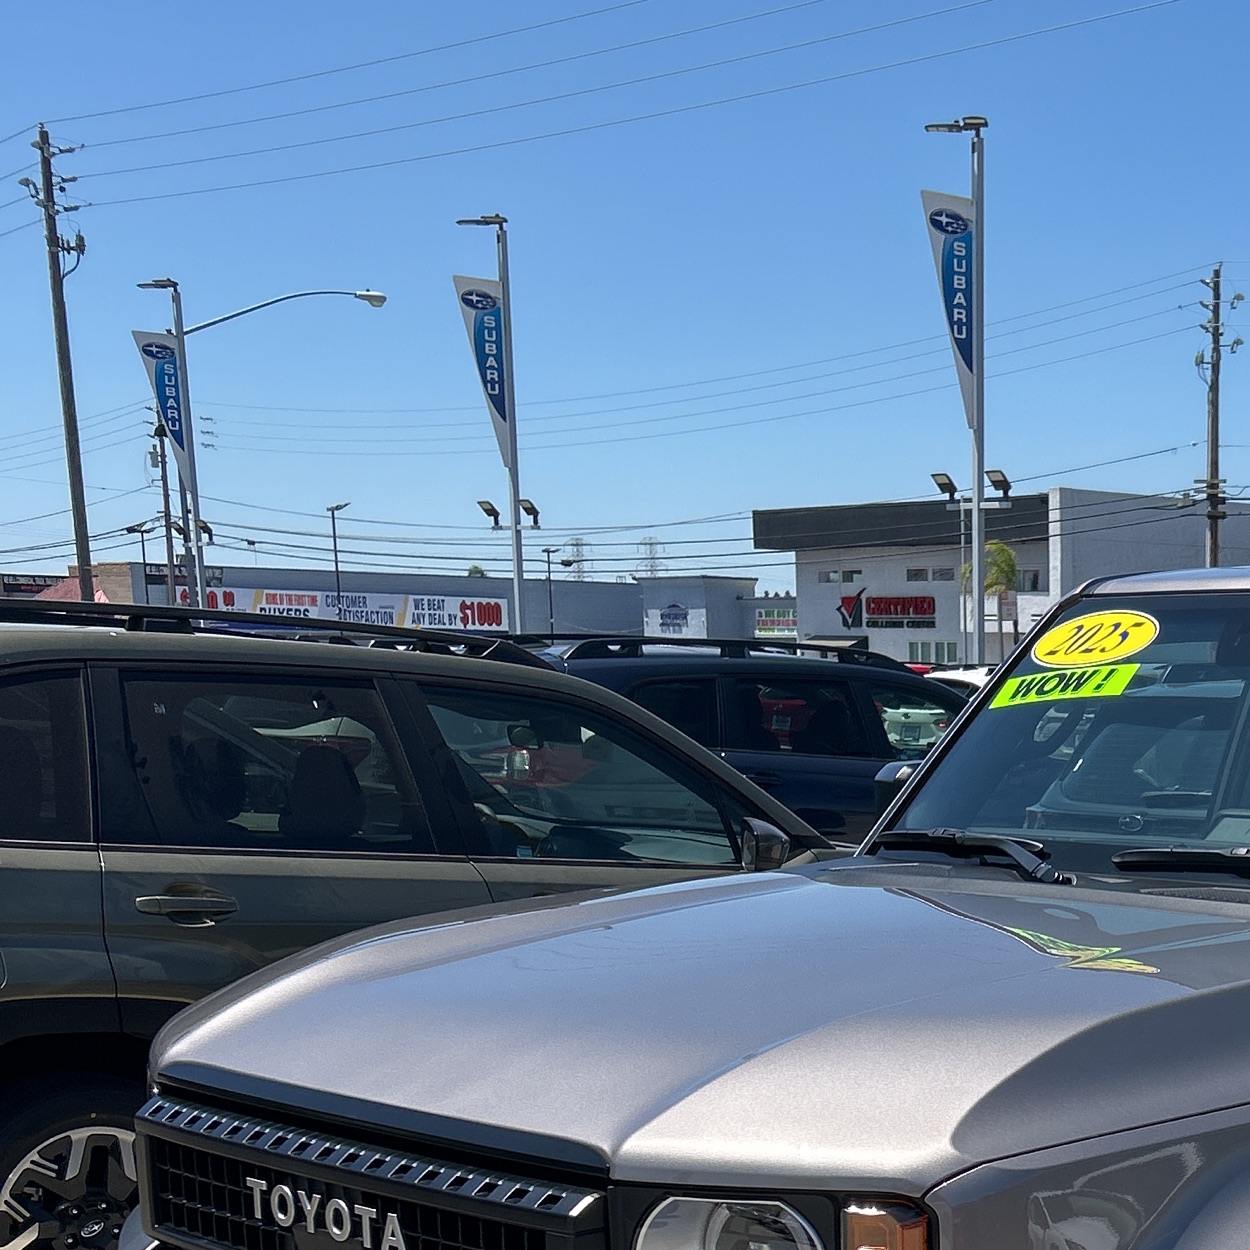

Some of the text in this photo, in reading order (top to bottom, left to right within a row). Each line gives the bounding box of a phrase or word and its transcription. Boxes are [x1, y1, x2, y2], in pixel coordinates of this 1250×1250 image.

[953, 241, 968, 339] SUBARU
[483, 315, 501, 395] SUBARU
[163, 364, 180, 431] SUBARU
[325, 594, 368, 609] CUTOMER
[413, 598, 445, 611] WE BEAT
[459, 600, 502, 628] $1000
[866, 597, 935, 616] CERTIFIED
[411, 612, 457, 626] ANY DEAL BY
[1043, 622, 1147, 656] 2025
